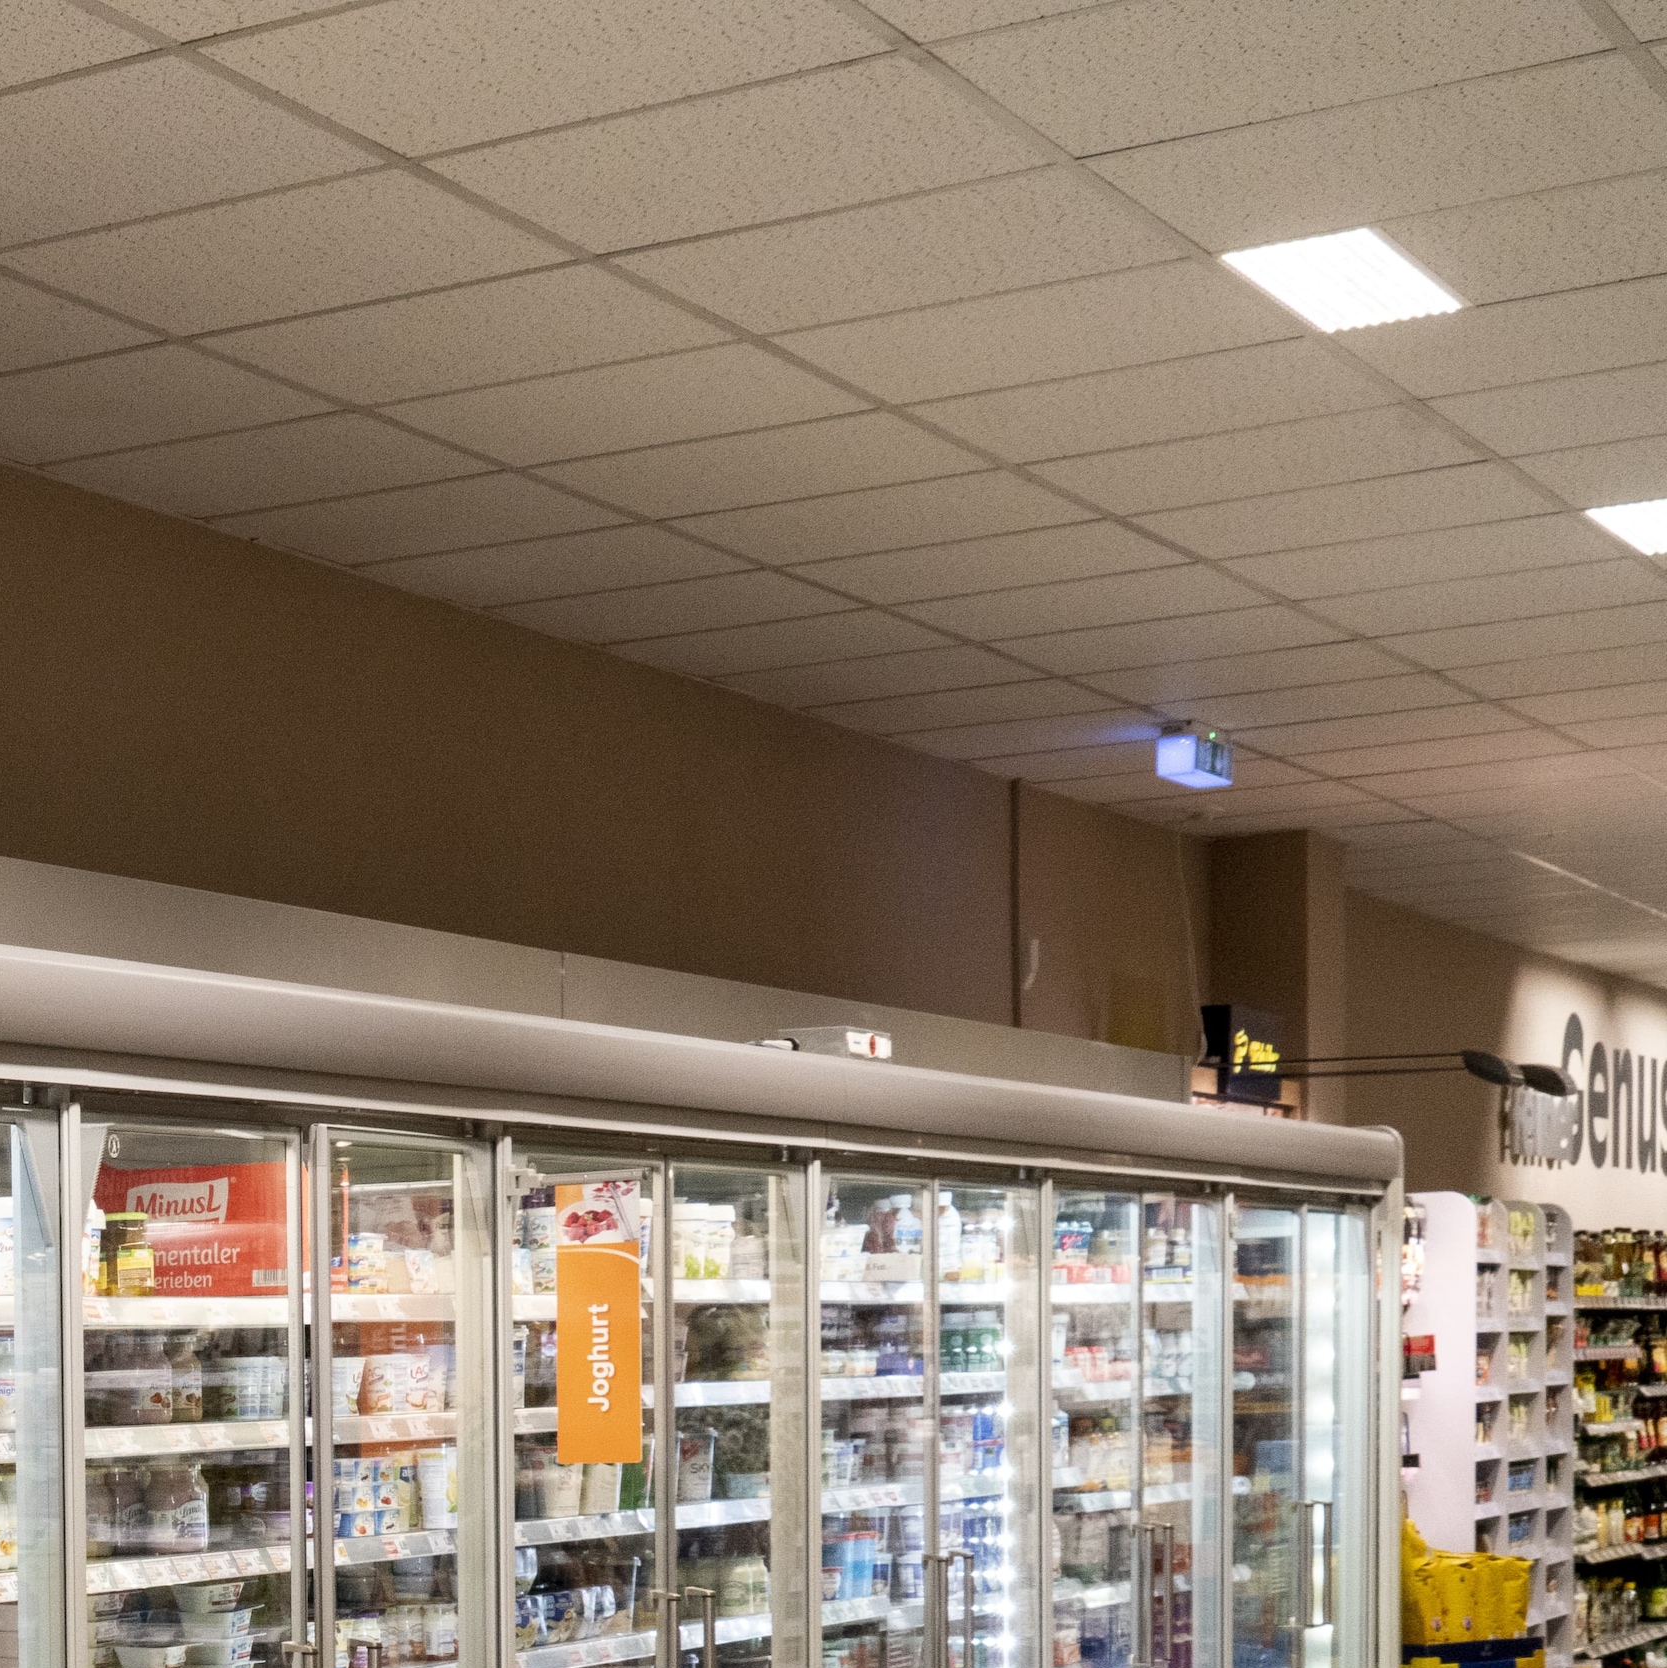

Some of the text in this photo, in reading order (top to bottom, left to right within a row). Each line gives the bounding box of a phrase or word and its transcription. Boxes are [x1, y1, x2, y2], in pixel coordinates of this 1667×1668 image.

[1562, 1012, 1667, 1172] Genu
[133, 1184, 222, 1220] MinusL
[587, 1304, 614, 1412] Joghurt
